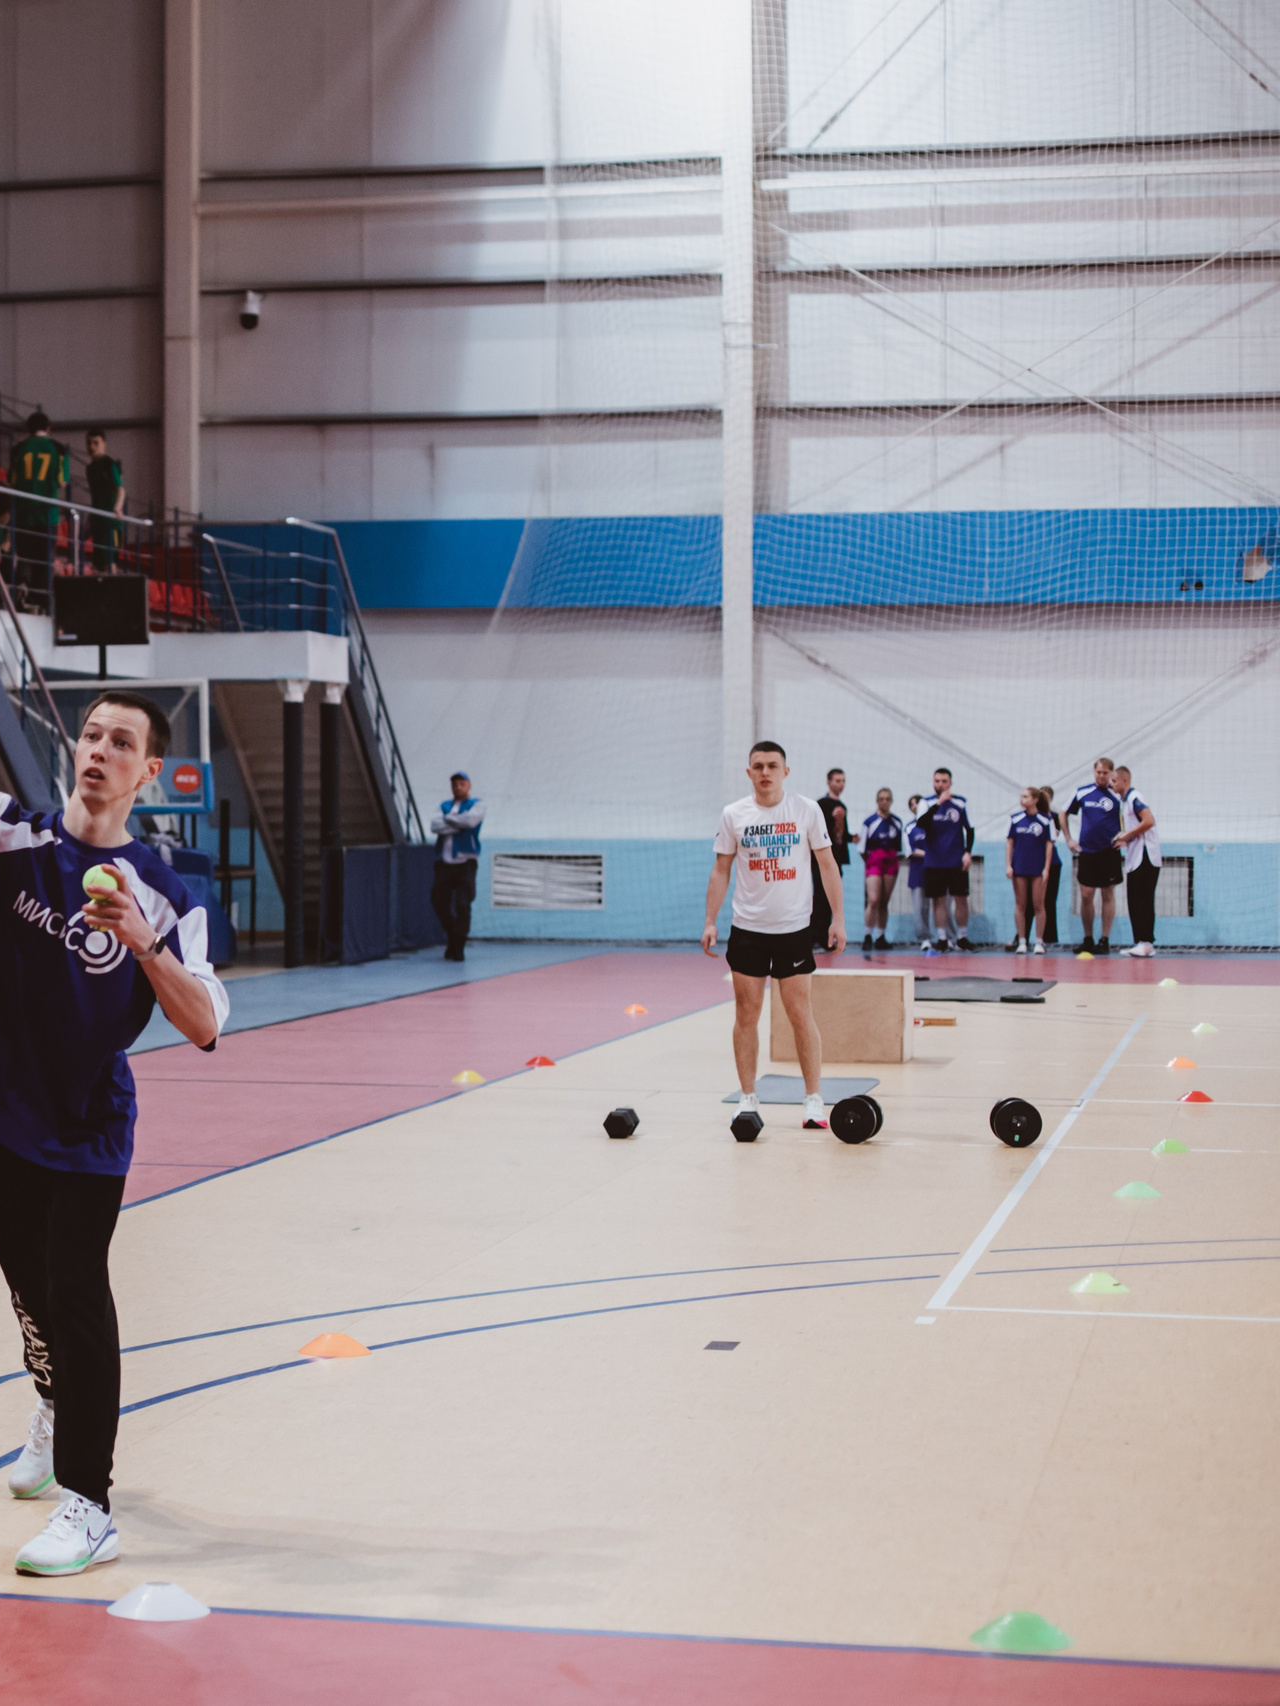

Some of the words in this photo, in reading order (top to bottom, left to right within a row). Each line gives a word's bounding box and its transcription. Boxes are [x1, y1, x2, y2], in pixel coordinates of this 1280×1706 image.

[23, 452, 51, 481] 17
[759, 833, 801, 847] ПЛАНЕТЫ
[766, 845, 792, 858] БЕГУТ
[748, 858, 779, 871] ВМЕСТЕ
[772, 866, 797, 881] ТОБОЙ
